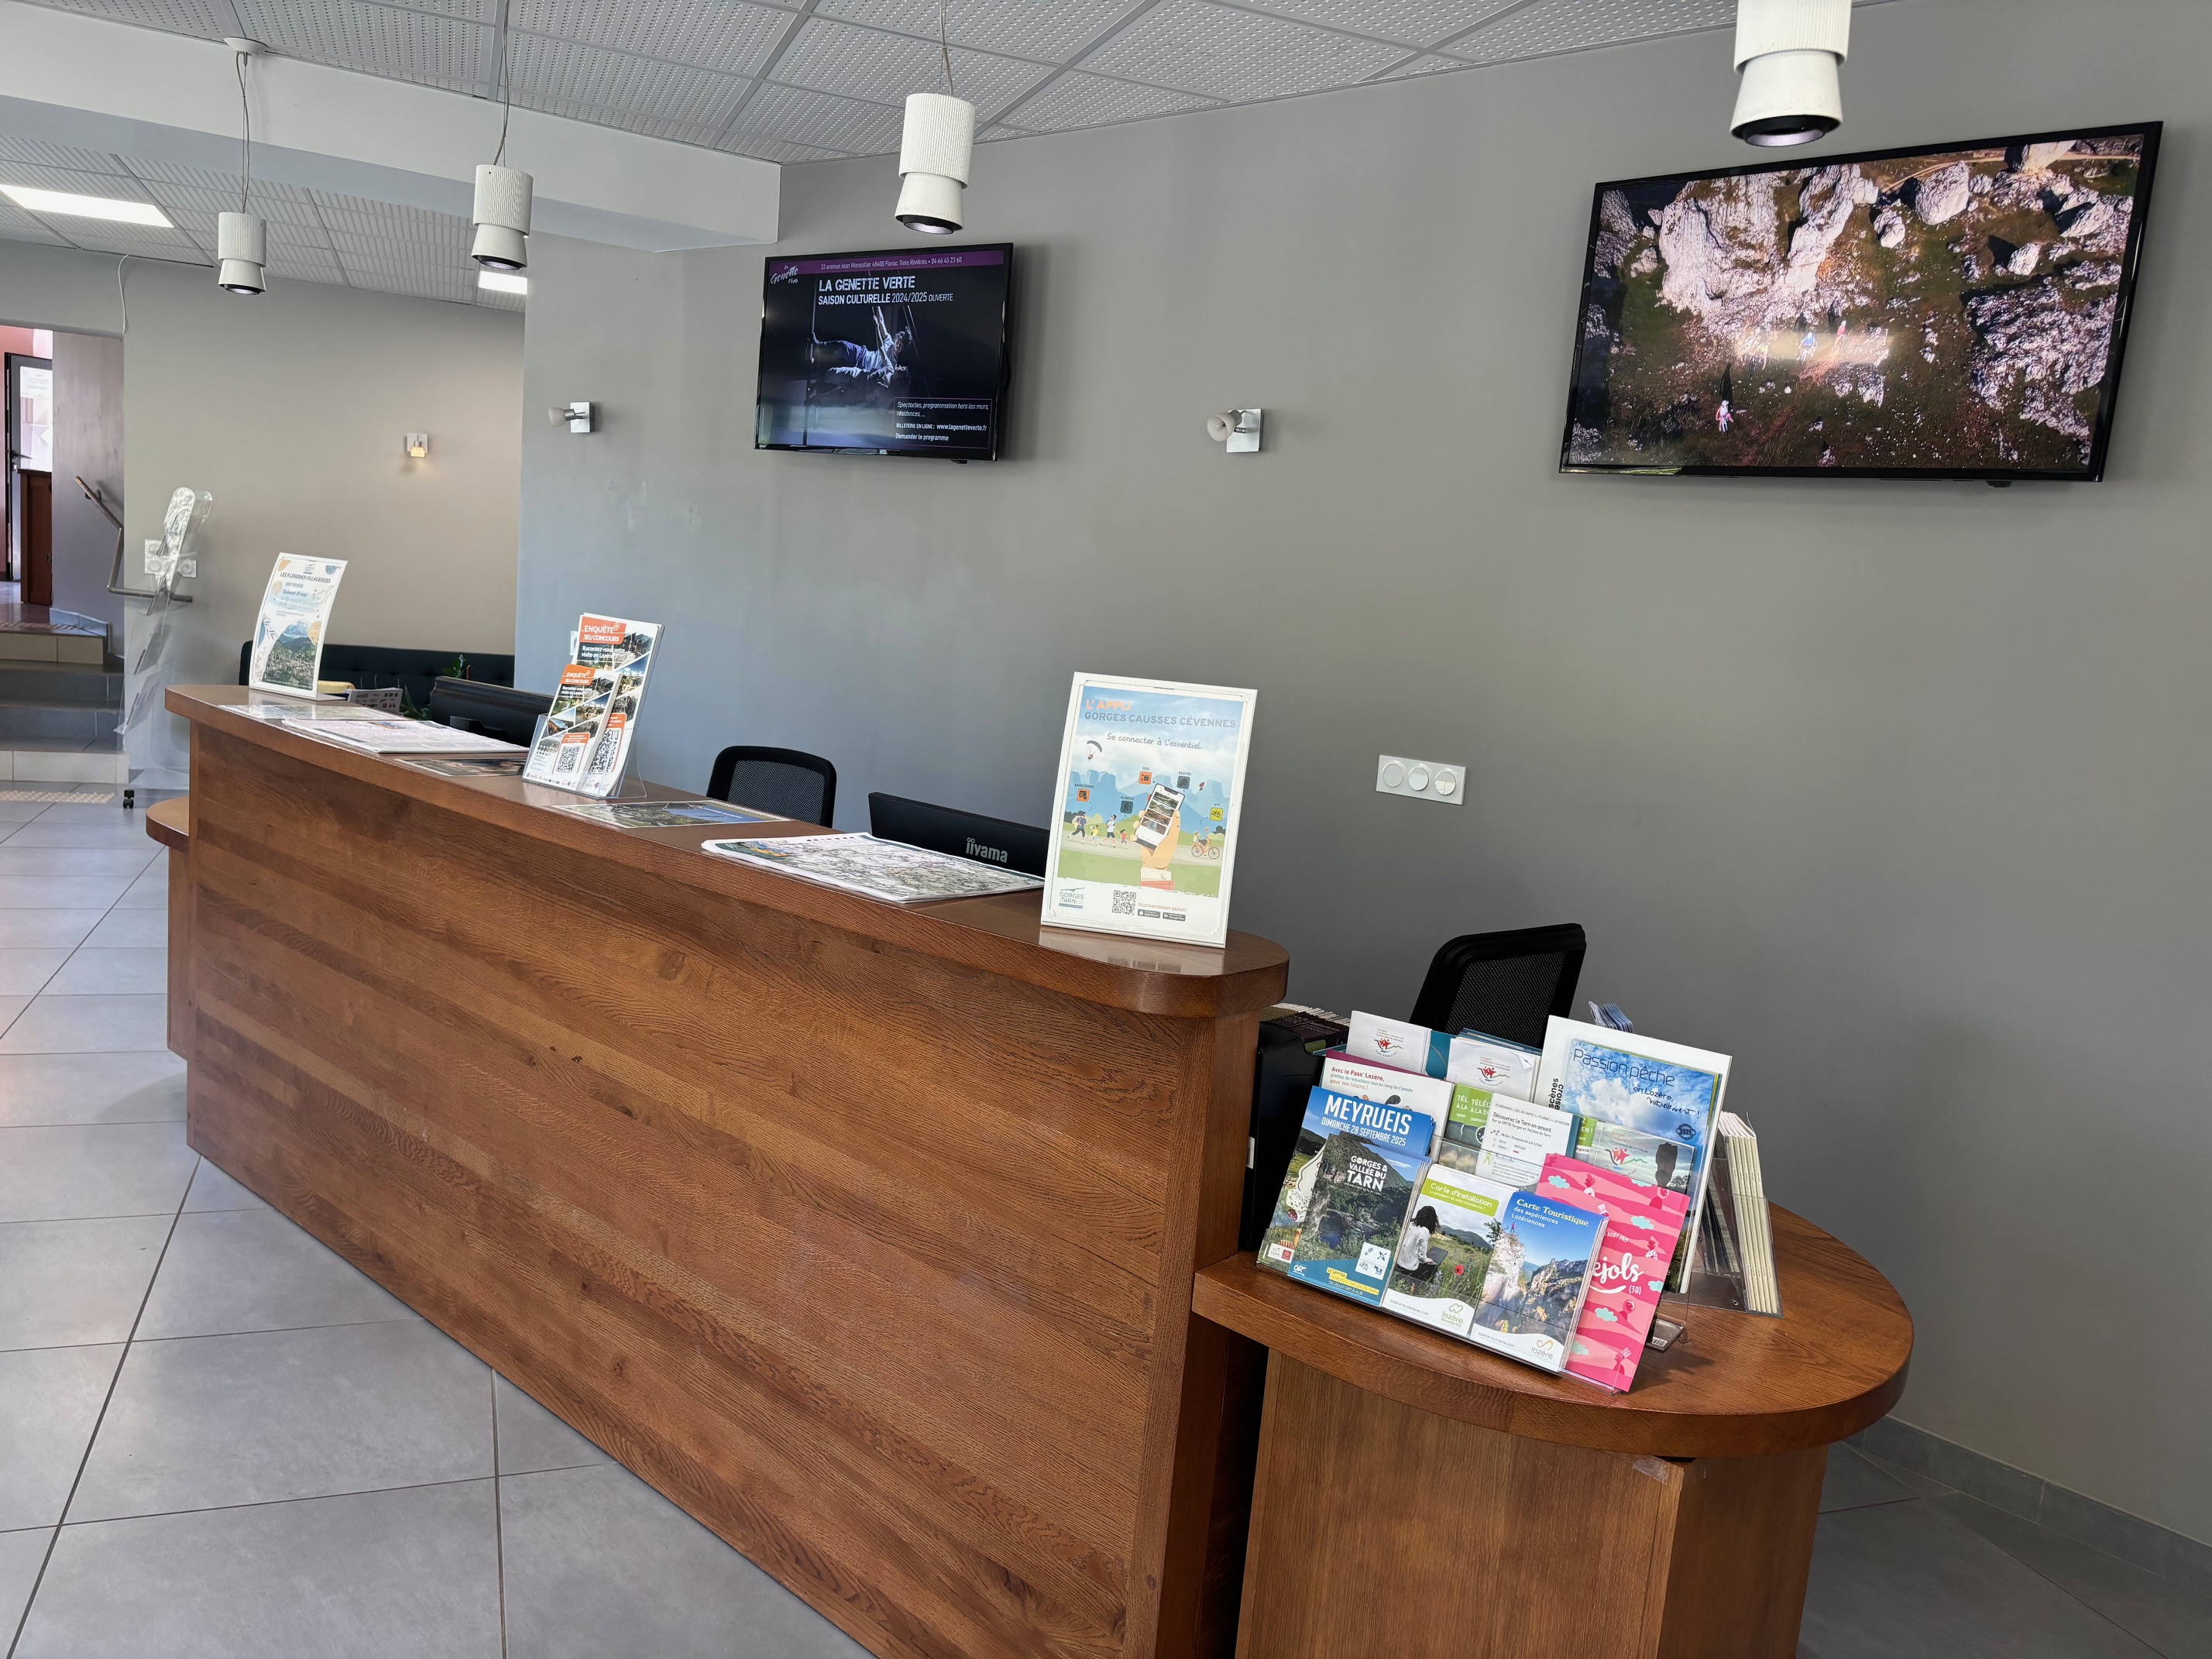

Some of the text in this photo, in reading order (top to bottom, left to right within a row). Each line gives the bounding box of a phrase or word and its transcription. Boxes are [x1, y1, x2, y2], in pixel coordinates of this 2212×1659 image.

[819, 276, 915, 292] LA GENETTE VERTE
[818, 291, 953, 305] SAISON CULTURELLE 2024/2025 OUVERTE
[584, 625, 614, 634] ENQUÊTE
[1084, 712, 1236, 728] GORGES CAUSSES CÉVENNES
[1118, 736, 1155, 745] connecter
[1157, 737, 1163, 746] à
[1164, 739, 1202, 750] l'essentiel
[966, 837, 1008, 864] iiyama
[1060, 891, 1084, 900] GORGES
[1573, 1049, 1675, 1087] Passion pêche
[1365, 1072, 1385, 1082] Lozère,
[1457, 1094, 1468, 1103] TÉL
[1548, 1077, 1559, 1108] scènes
[1633, 1086, 1674, 1102] en Lozère,
[1324, 1094, 1412, 1135] MEYRUEIS
[1493, 1112, 1515, 1123] Découvrez
[1321, 1117, 1407, 1146] DIMANCHE 28 SEPTEMBRE 2025
[1349, 1163, 1386, 1180] VALLÉE DU
[1351, 1156, 1388, 1173] GORGES &
[1347, 1170, 1385, 1192] TARN
[1431, 1183, 1450, 1194] Carte
[1516, 1199, 1589, 1227] Carte Touristique
[1525, 1211, 1559, 1224] expériences
[1511, 1213, 1546, 1228] Lozériennes
[1331, 1275, 1345, 1283] GORGES
[1629, 1285, 1642, 1295] (30)
[1441, 1310, 1463, 1324] lozère
[1531, 1346, 1554, 1360] lozère
